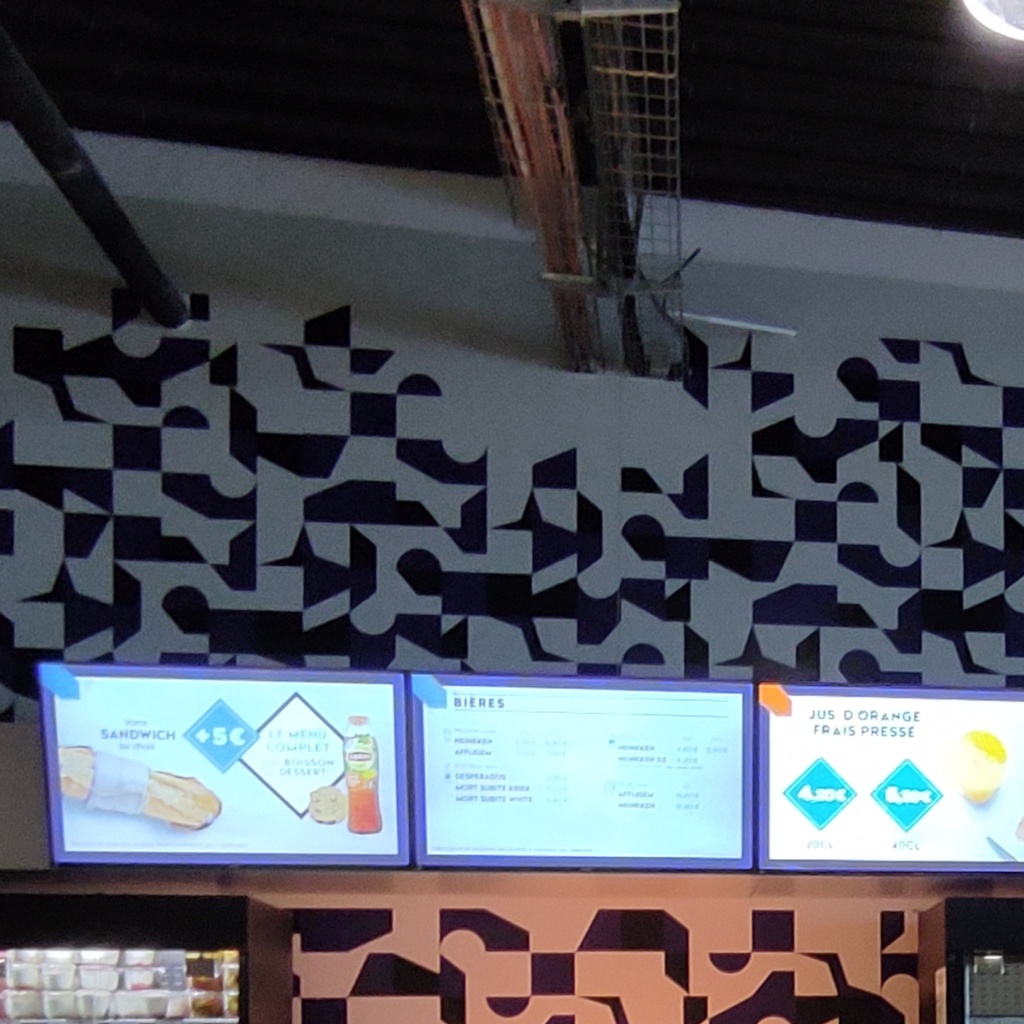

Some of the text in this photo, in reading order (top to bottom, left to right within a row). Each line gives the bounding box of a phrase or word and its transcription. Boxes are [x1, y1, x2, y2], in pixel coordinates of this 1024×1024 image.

[453, 694, 505, 709] BIÈRES
[809, 709, 835, 720] JUS
[100, 728, 176, 741] SANDWICH
[288, 729, 328, 739] MENU
[813, 724, 915, 738] FRAIS PRESSÉ
[266, 742, 331, 753] COMPLET
[284, 758, 335, 766] BOISSON
[279, 768, 326, 776] DESSERT
